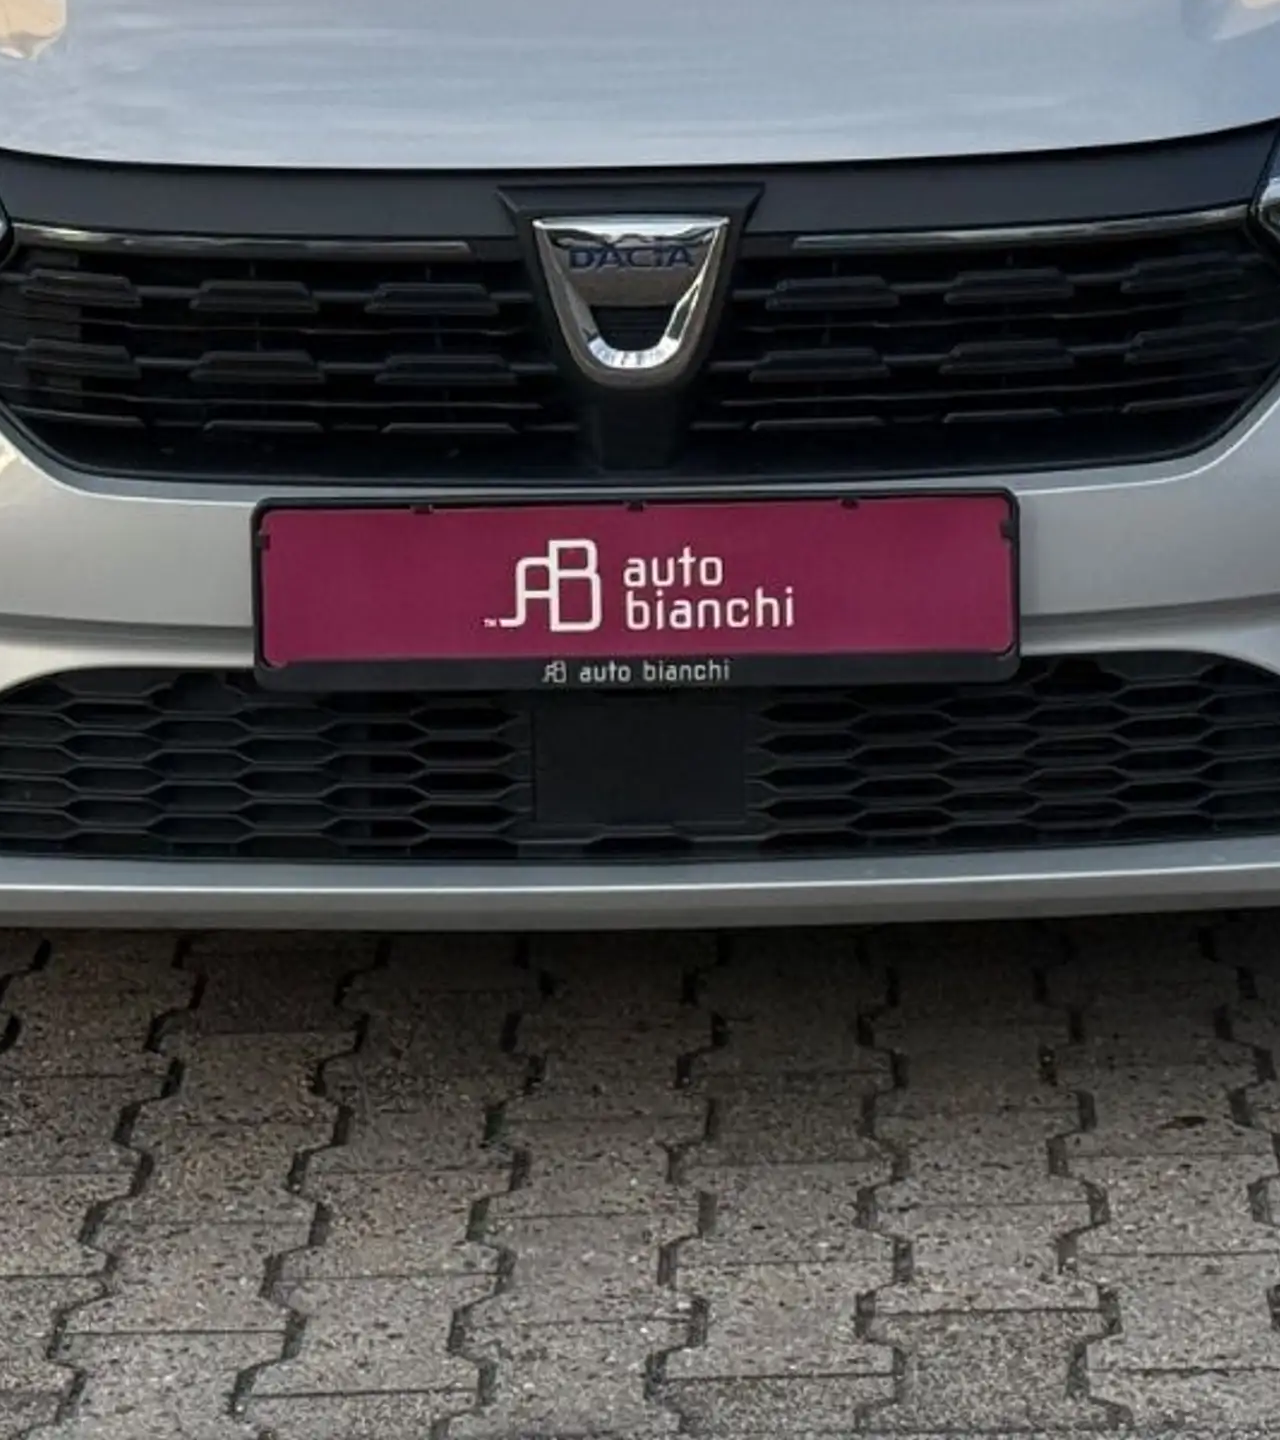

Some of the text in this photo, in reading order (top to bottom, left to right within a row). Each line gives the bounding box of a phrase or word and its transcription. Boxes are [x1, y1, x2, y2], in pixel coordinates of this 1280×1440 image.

[569, 244, 695, 269] DACIA
[622, 546, 724, 588] auto
[625, 585, 795, 631] bianchi
[579, 660, 632, 683] auto
[642, 658, 731, 683] bianchi
